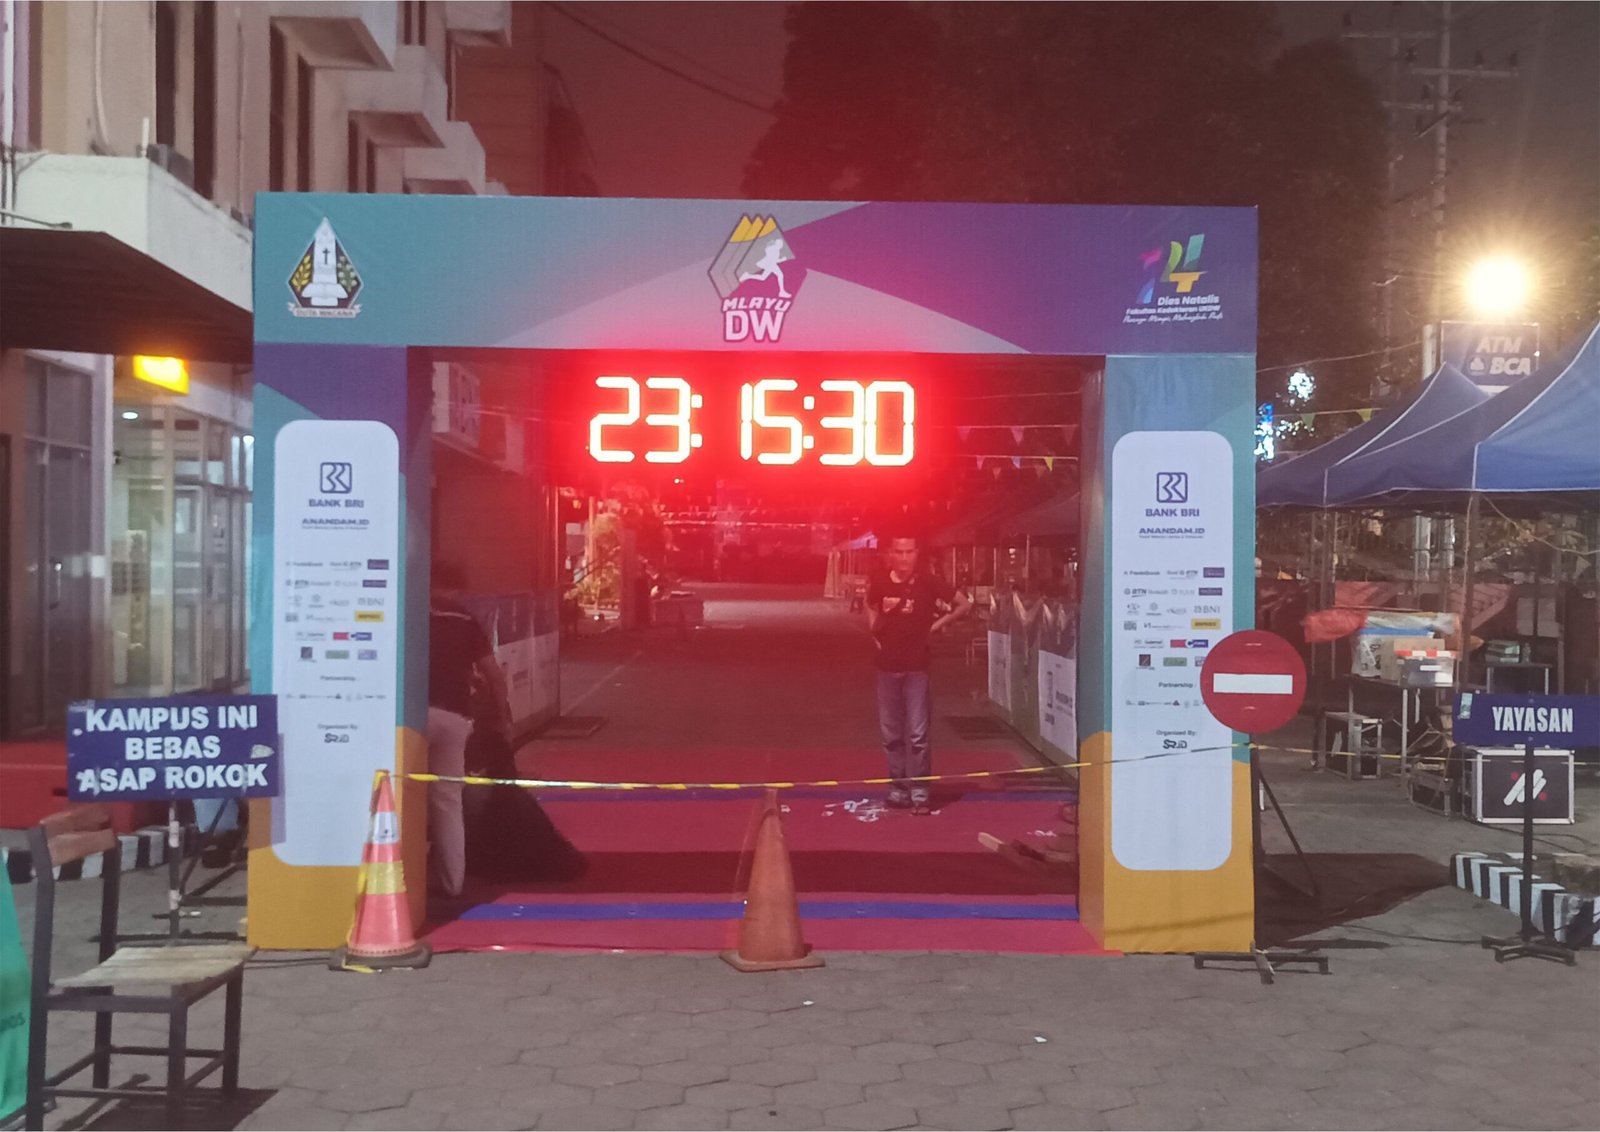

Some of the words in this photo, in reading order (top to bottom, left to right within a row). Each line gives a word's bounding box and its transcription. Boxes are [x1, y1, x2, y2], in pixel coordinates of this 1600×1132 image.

[722, 297, 791, 313] MLAYU
[1157, 295, 1180, 306] Dies
[1181, 293, 1220, 305] Natalis
[725, 311, 785, 340] DW
[1476, 336, 1523, 353] ATM
[1489, 357, 1531, 375] BCA
[308, 498, 341, 508] BANK
[344, 499, 364, 508] BRI
[1145, 508, 1177, 517] BANK
[1181, 508, 1200, 517] BRI
[85, 706, 209, 733] KAMPUS
[217, 705, 258, 730] INI
[1491, 706, 1574, 733] YAYASAN
[124, 735, 221, 761] BEBAS
[77, 766, 157, 793] ASAP
[164, 763, 269, 790] ROKOK
